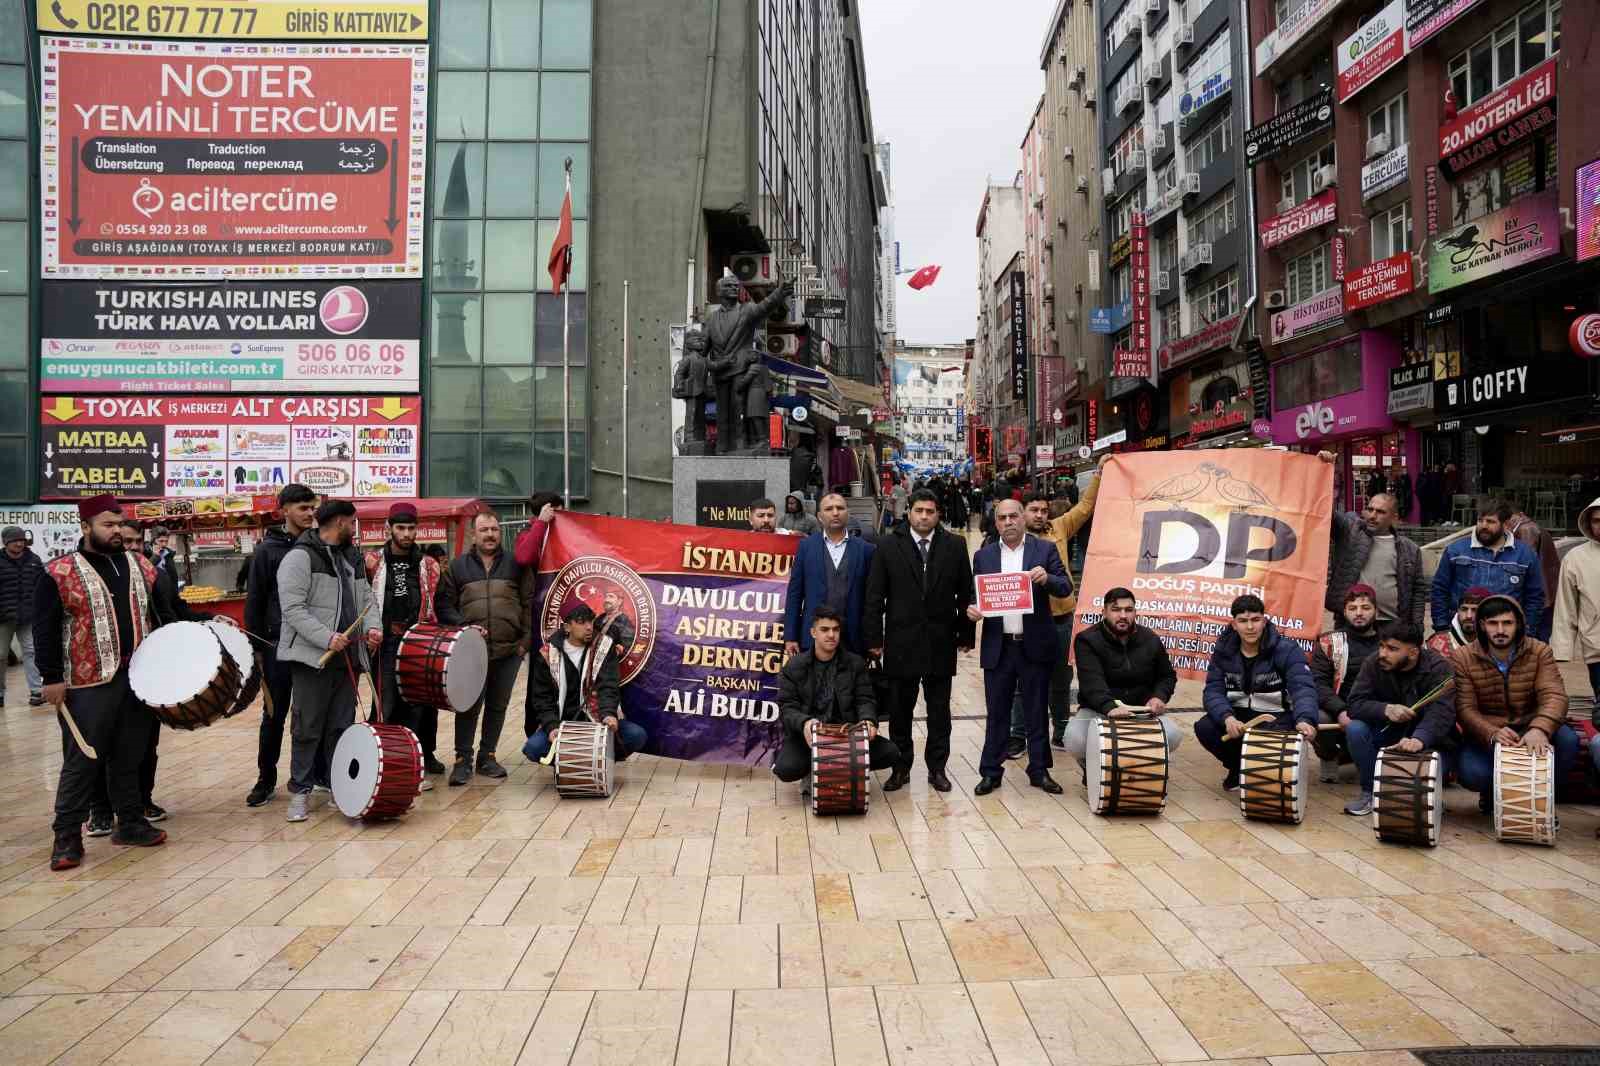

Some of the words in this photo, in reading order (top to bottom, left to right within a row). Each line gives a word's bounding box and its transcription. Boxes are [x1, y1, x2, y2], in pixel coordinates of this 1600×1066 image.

[87, 3, 139, 32] 0212
[147, 6, 188, 33] 677
[196, 8, 223, 34] 77
[230, 9, 257, 34] 77
[286, 9, 328, 35] GİRİŞ
[334, 12, 408, 33] KATTAYIZ
[161, 64, 315, 98] NOTER
[73, 101, 219, 133] YEMİNLİ
[228, 101, 398, 133] TERCÜME
[1442, 72, 1551, 154] 20.NOTERLİĞİ
[96, 142, 157, 154] Translation
[208, 143, 266, 155] Traduction
[95, 156, 164, 172] Übersetzung
[187, 158, 235, 171] Перевод
[244, 160, 304, 171] переклад
[1363, 155, 1406, 186] TERCÜME
[170, 187, 338, 212] aciltercüme
[116, 224, 146, 235] 0554
[149, 224, 171, 235] 920
[174, 224, 189, 235] 23
[192, 224, 208, 235] 08
[235, 224, 368, 235] www.aciltercume.com.tr
[1262, 203, 1336, 249] TERCÜME
[92, 240, 123, 255] GİRİŞ
[127, 240, 184, 255] AŞAĞIDAN
[188, 241, 228, 255] (TOYAK
[232, 242, 244, 255] İŞ
[248, 242, 296, 253] MERKEZİ
[300, 242, 345, 253] BODRUM
[350, 242, 375, 254] KAT)
[1468, 251, 1501, 269] KAYNAK
[1347, 274, 1372, 292] NOTER
[1374, 259, 1408, 283] YEMİNLİ
[96, 289, 204, 309] TURKISH
[210, 290, 317, 309] AIRLINES
[1358, 279, 1397, 302] TERCÜME
[95, 312, 154, 331] TÜRK
[160, 314, 220, 331] HAVA
[226, 315, 316, 331] YOLLARI
[1436, 305, 1452, 318] COFFY
[1015, 301, 1023, 355] ENGLISH
[247, 344, 285, 354] SunExpress
[298, 344, 337, 362] 506
[346, 344, 371, 362] 06
[379, 344, 405, 362] 06
[46, 361, 277, 378] enuygunucakbileti.com.tr
[331, 365, 393, 375] KATTAYIZ
[1016, 363, 1024, 395] PARK
[120, 381, 153, 392] Flight
[156, 381, 192, 391] Ticket
[194, 381, 225, 391] Sales
[1472, 365, 1529, 402] COFFY
[83, 399, 164, 418] TOYAK
[168, 403, 178, 417] İŞ
[180, 401, 228, 414] MERKEZİ
[231, 399, 275, 417] ALT
[280, 398, 369, 422] ÇARŞISI
[1296, 402, 1334, 439] eve
[1444, 420, 1460, 431] COFFY
[58, 431, 148, 448] MATBAA
[294, 426, 332, 439] TERZİ
[58, 468, 147, 484] TABELA
[369, 462, 413, 476] TERZİ
[1136, 510, 1297, 580] DP
[563, 562, 602, 584] DAVULCU
[986, 583, 1021, 592] MUHTAR
[1132, 576, 1196, 593] DOĞUŞ
[1200, 582, 1264, 601] PARTİSİ
[661, 585, 785, 615] DAVULCUL
[675, 615, 784, 644] AŞİRETLE
[1142, 616, 1192, 633] DOMLARIN
[1195, 622, 1222, 636] EMEK
[1179, 636, 1200, 652] SESİ
[706, 676, 760, 693] BAŞKANI
[664, 689, 704, 715] ALİ
[711, 694, 779, 722] BULD
